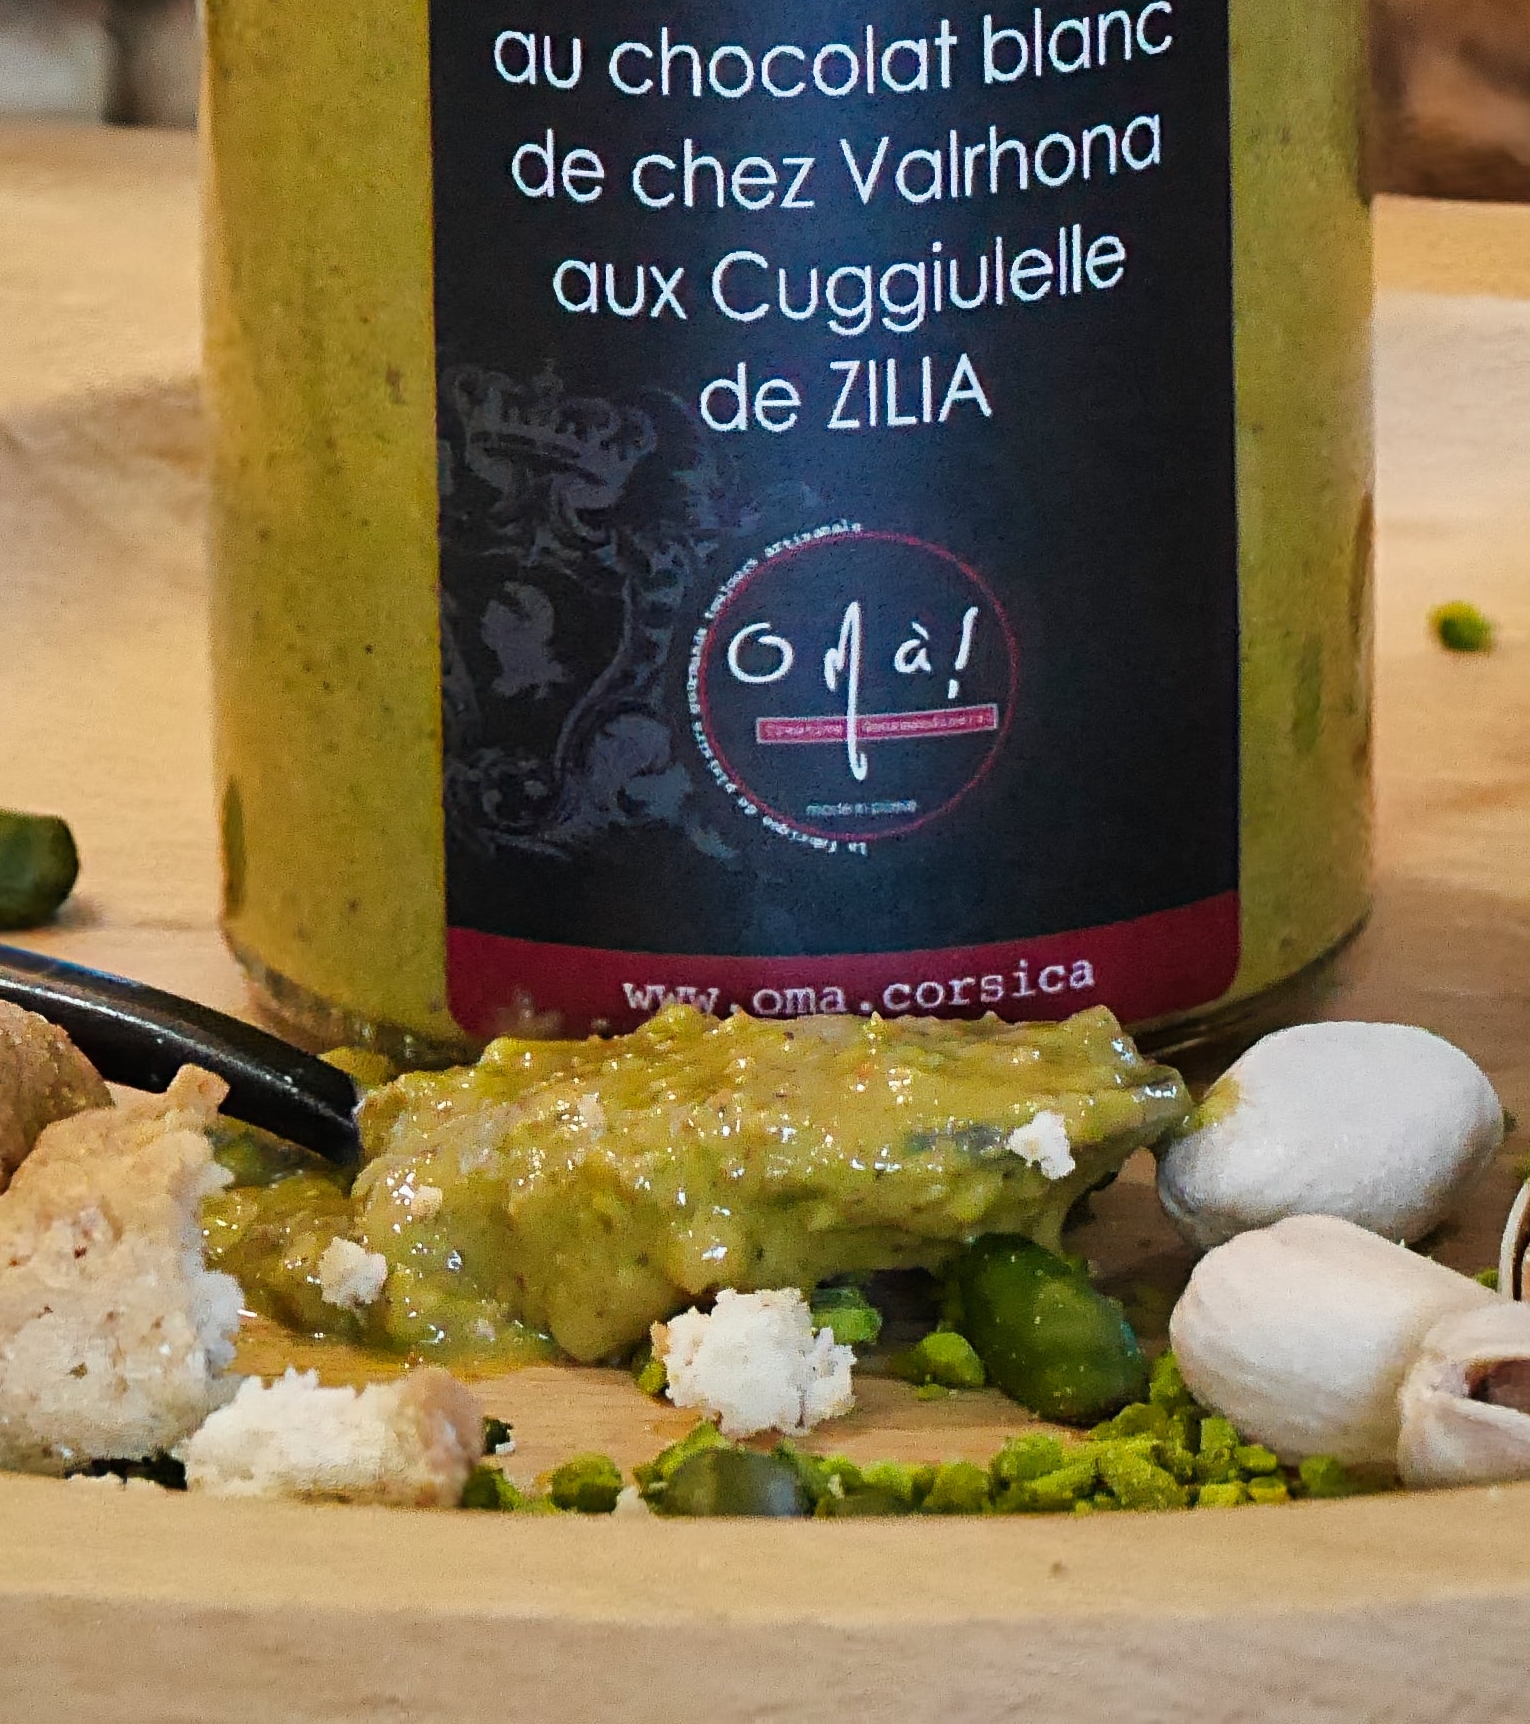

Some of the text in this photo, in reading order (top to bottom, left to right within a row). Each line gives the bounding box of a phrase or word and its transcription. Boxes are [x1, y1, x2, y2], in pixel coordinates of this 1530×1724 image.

[493, 0, 1173, 99] au chocolat blanc
[511, 114, 1161, 211] de chez Valrhona
[552, 223, 1126, 337] aux Cuggiulelle
[699, 352, 992, 433] de ZILIA
[622, 958, 1096, 1016] www.oma.corsica
